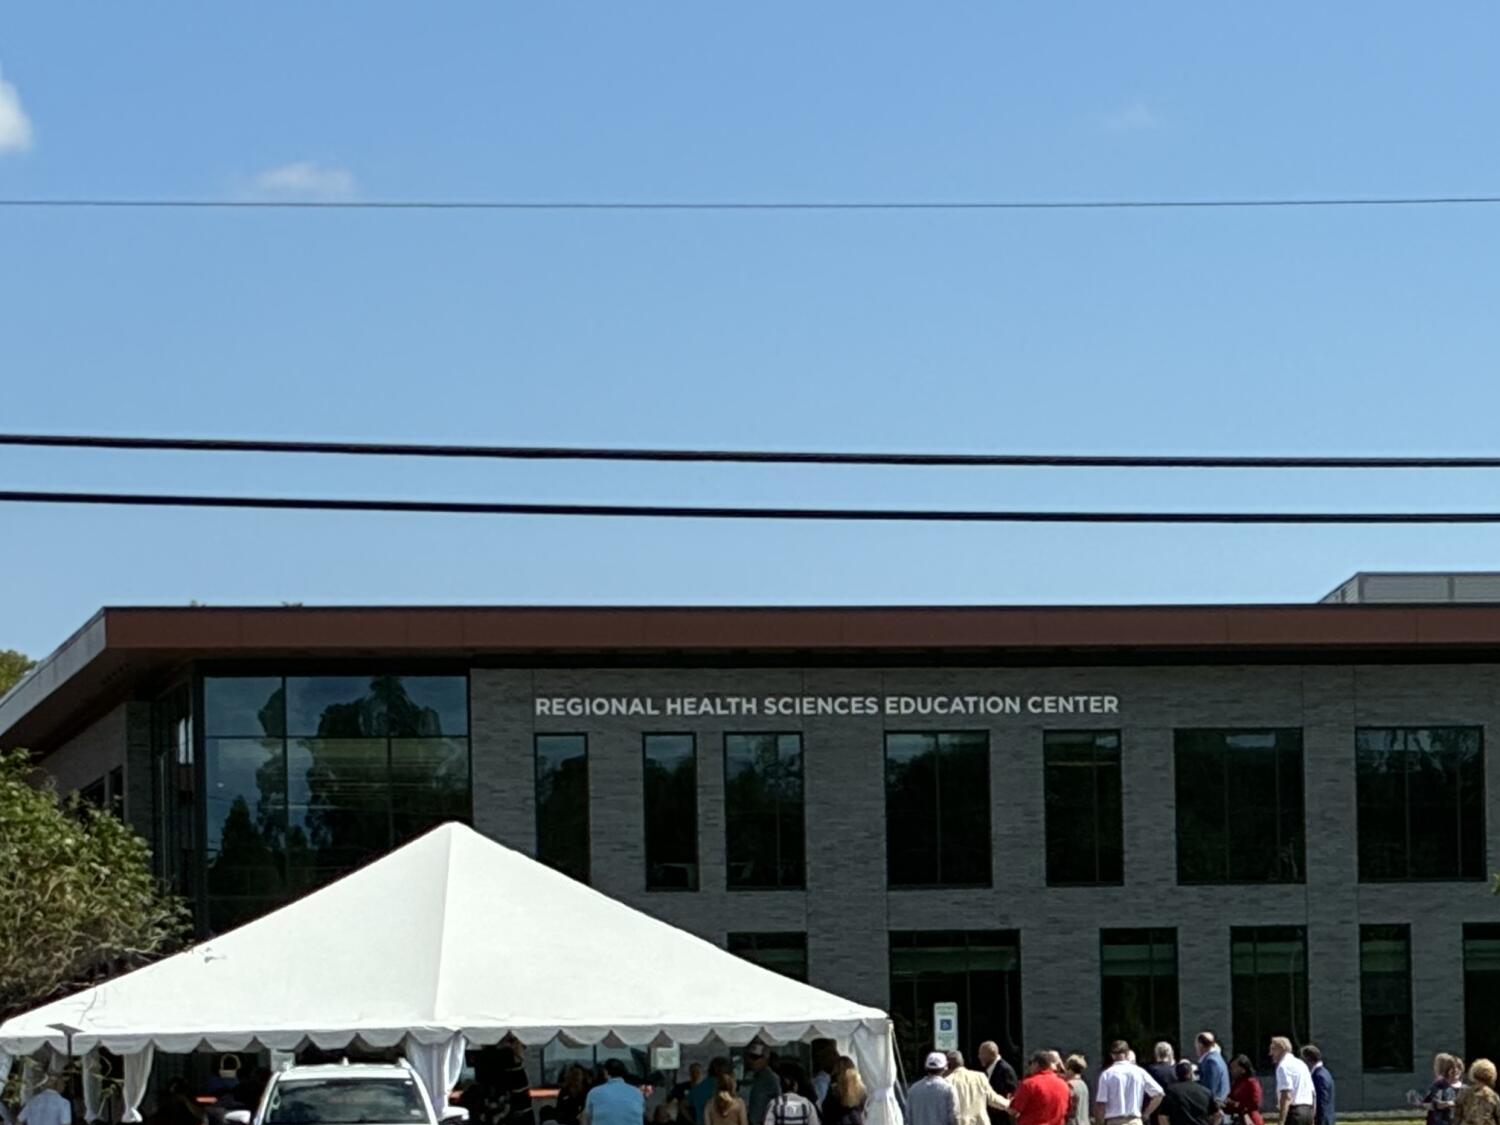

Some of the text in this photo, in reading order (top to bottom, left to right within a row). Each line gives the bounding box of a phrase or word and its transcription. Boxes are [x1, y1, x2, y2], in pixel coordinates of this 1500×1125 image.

[535, 695, 1119, 716] REGIONAL HEALTH SCIENCES EDUCATION CENTER
